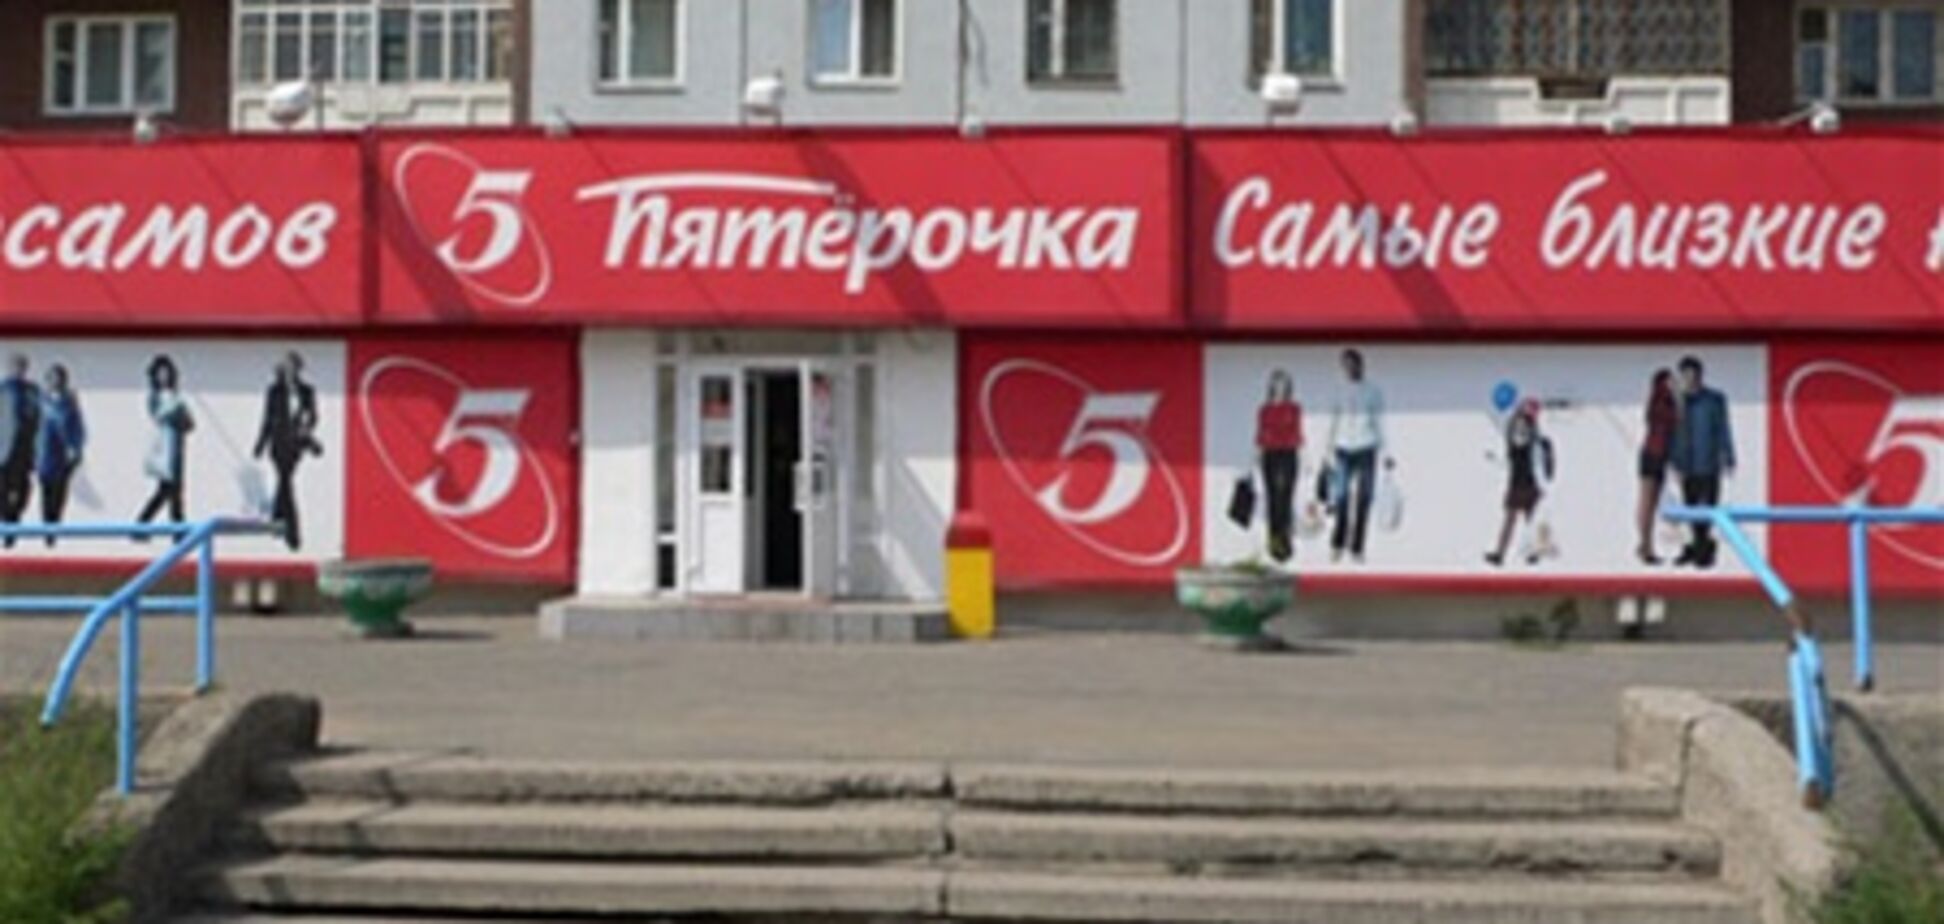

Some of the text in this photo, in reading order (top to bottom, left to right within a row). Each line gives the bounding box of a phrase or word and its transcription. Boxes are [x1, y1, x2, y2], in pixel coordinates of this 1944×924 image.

[0, 203, 337, 270] самов
[436, 170, 1139, 293] 5 Пятёрочка
[1215, 177, 1499, 270] Самые
[1540, 170, 1885, 270] близкие
[413, 389, 531, 518] 5
[1037, 392, 1162, 523] 5
